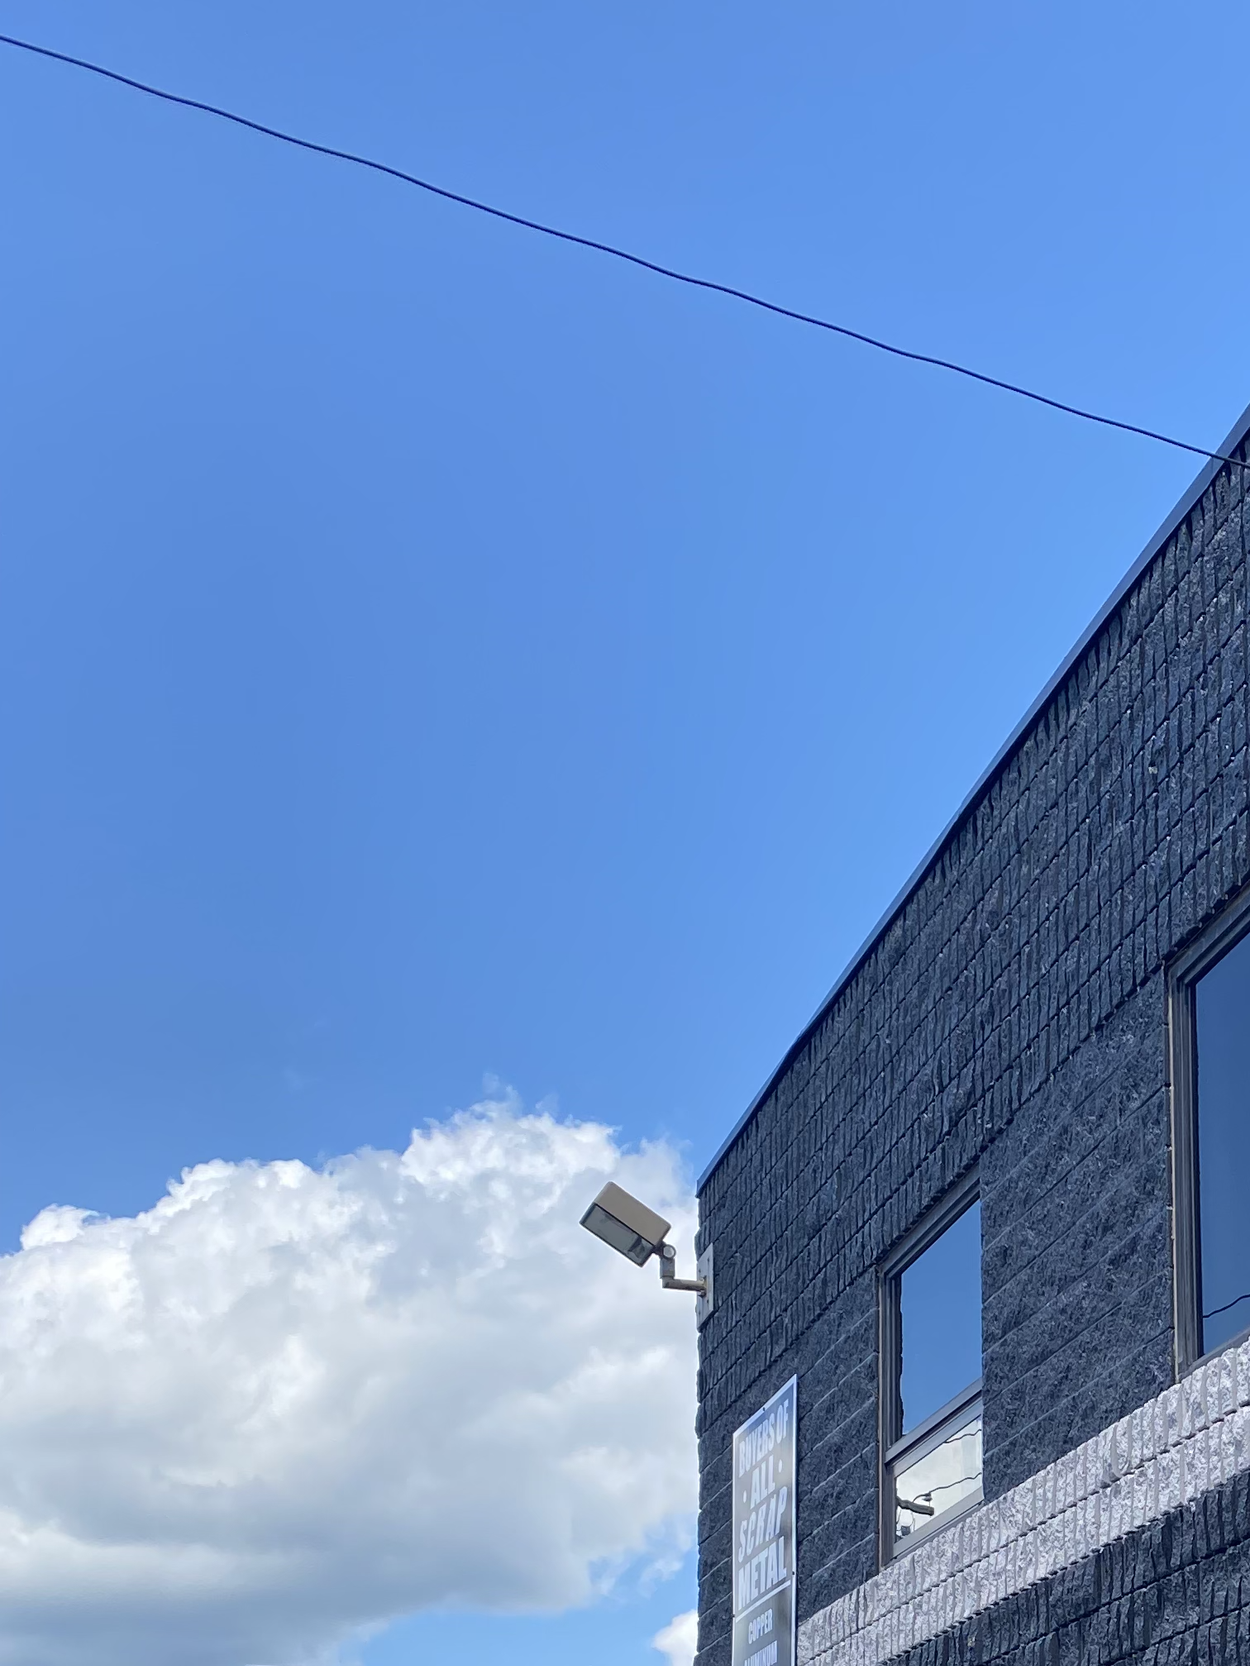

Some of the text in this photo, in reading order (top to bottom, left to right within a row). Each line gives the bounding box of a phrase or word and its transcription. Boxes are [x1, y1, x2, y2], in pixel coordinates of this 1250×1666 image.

[738, 1398, 790, 1478] BUYERS OF
[750, 1455, 775, 1509] ALL
[738, 1486, 787, 1563] SCRAP
[738, 1536, 787, 1610] METAL
[748, 1609, 773, 1645] COPPER
